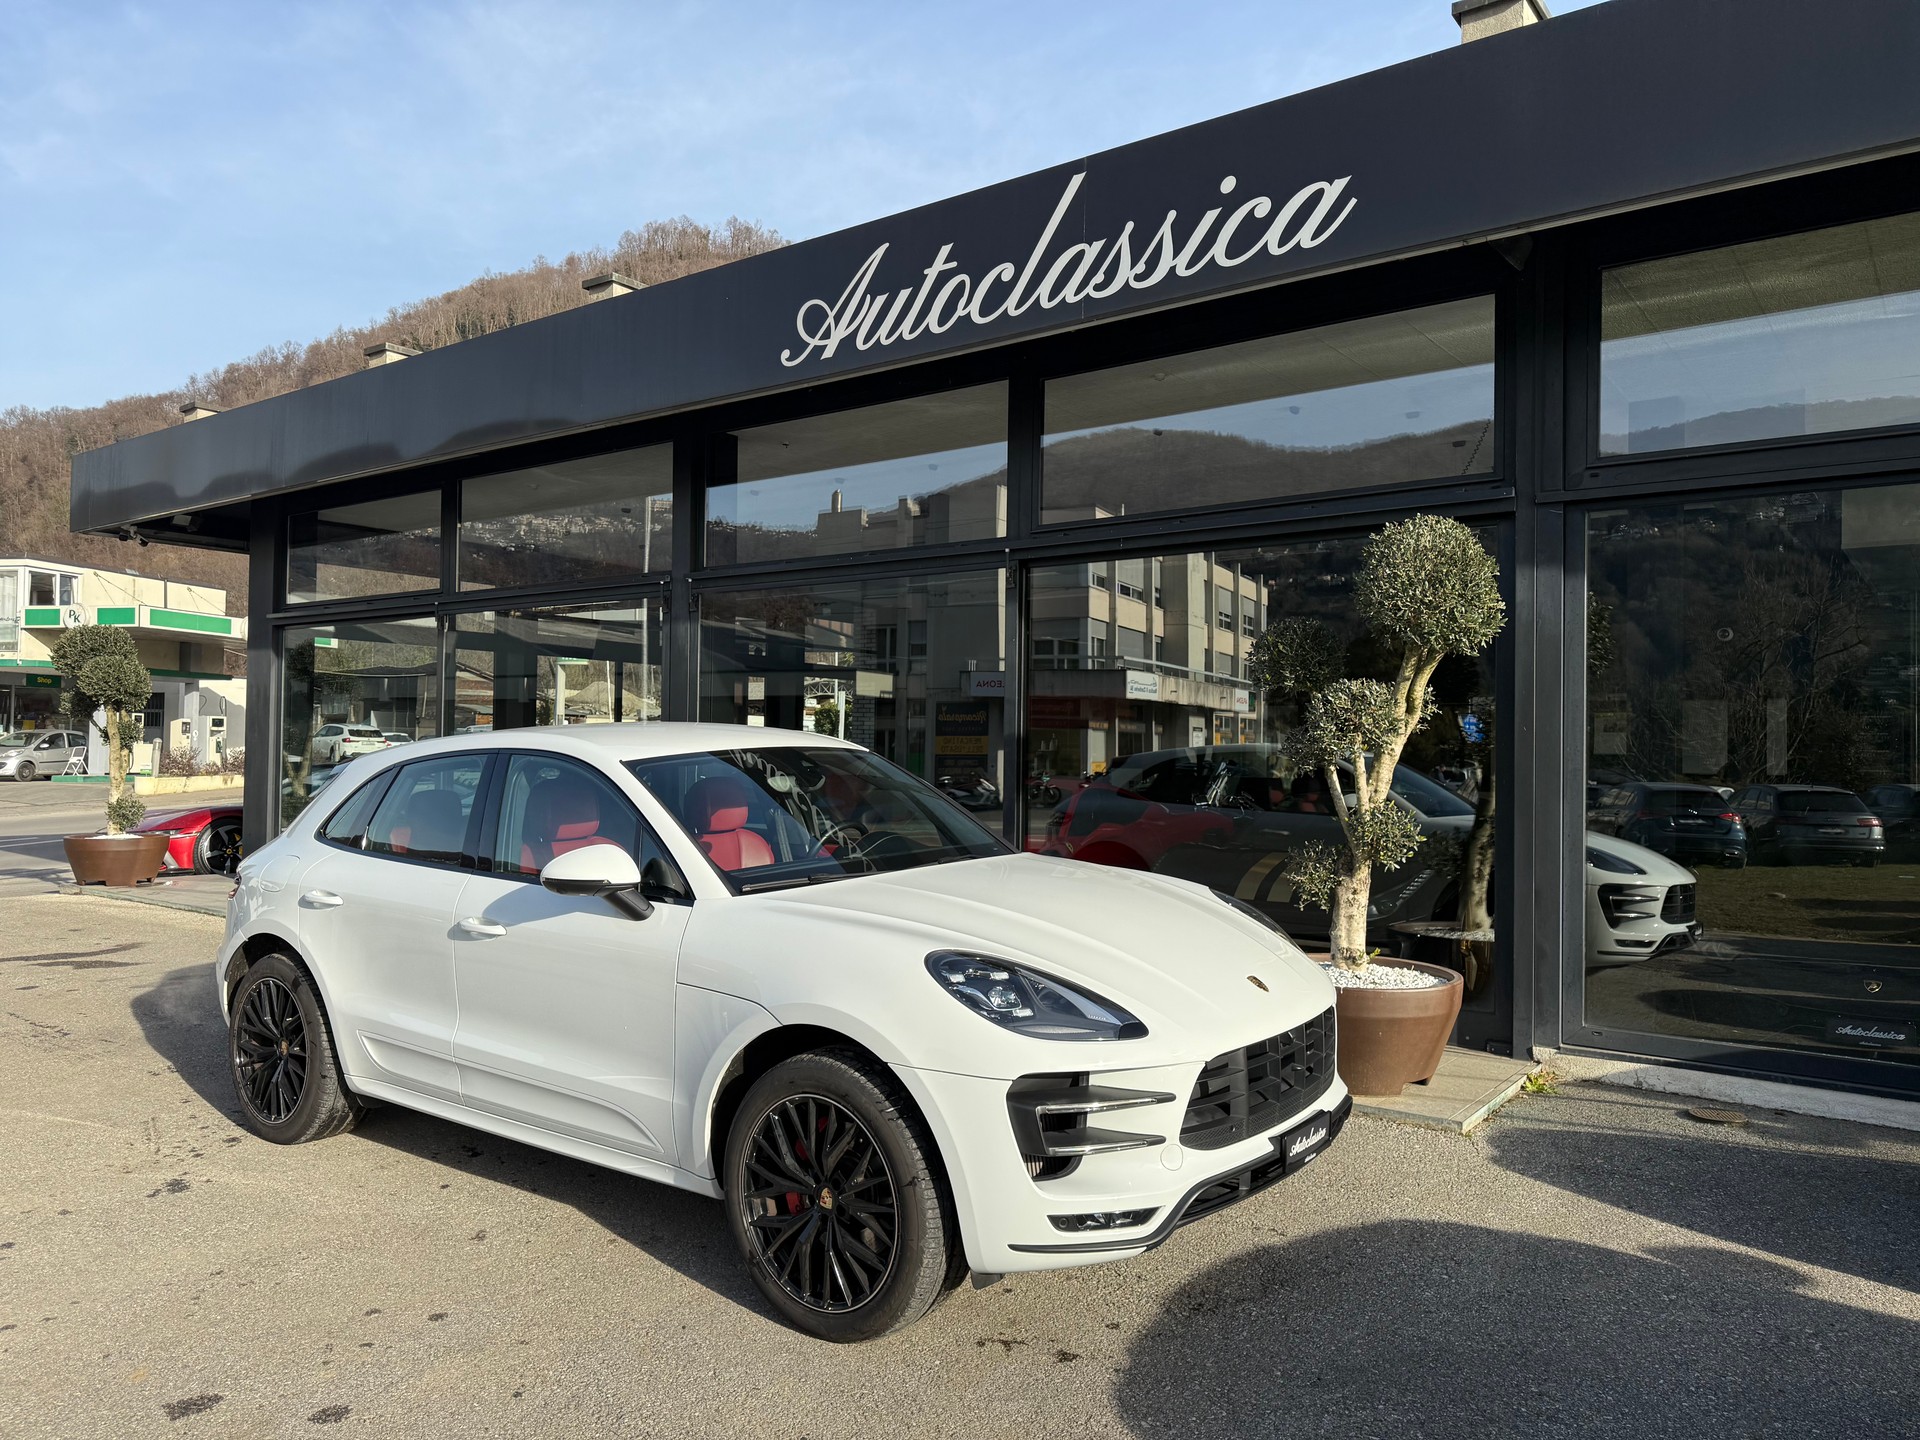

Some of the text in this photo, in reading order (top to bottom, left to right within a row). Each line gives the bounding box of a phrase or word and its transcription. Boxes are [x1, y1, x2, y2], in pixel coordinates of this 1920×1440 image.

[781, 172, 1357, 367] Autoclassica
[37, 677, 53, 685] Shop
[1835, 1024, 1906, 1040] Autoclassica
